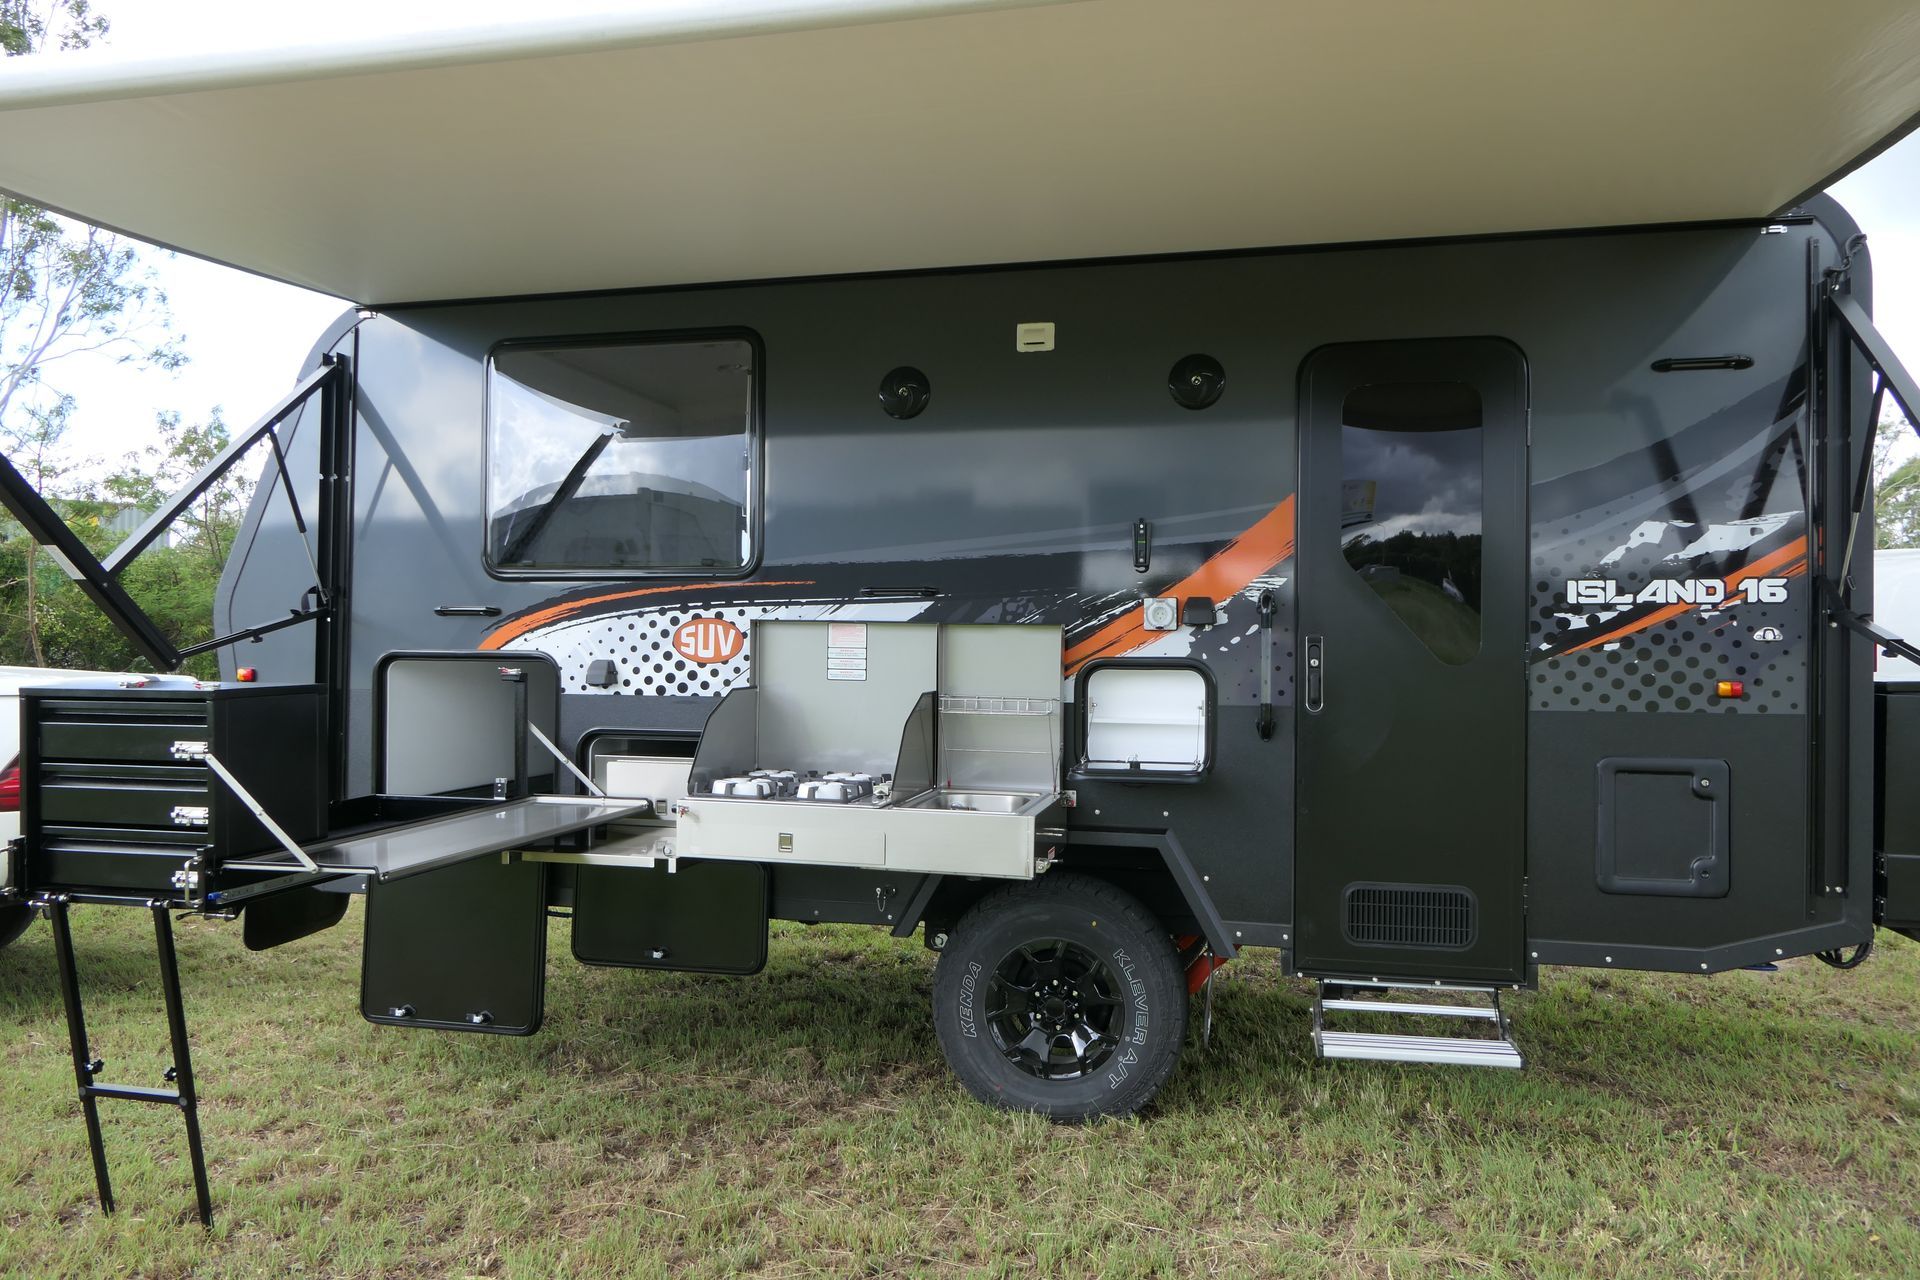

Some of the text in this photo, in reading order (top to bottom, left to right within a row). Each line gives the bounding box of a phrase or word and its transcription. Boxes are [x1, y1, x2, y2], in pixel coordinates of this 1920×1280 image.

[1566, 578, 1788, 604] ISLAND 16
[681, 623, 736, 658] SUV
[960, 961, 982, 1039] KENDA
[1108, 948, 1149, 1090] KLEVER A/T
